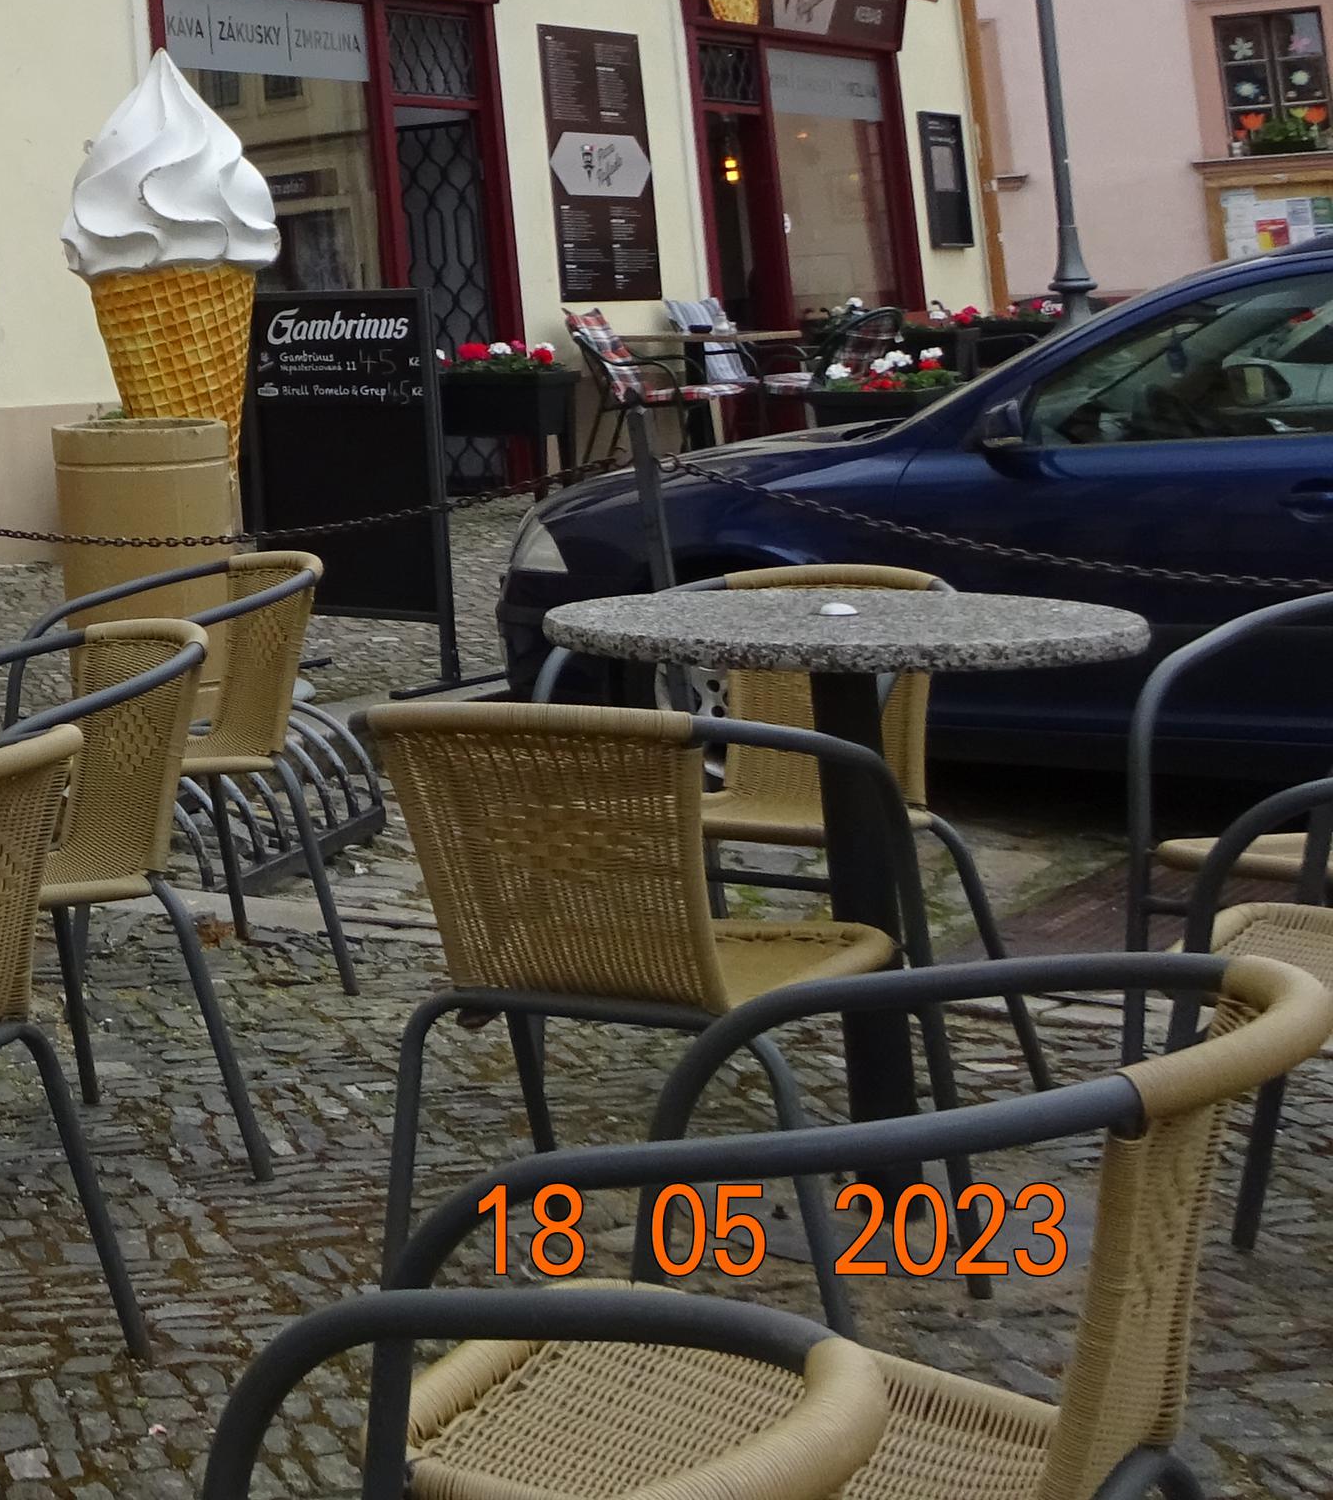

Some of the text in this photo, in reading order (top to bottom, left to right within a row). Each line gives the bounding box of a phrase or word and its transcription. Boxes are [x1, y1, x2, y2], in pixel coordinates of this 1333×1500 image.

[166, 11, 361, 53] KÁVA ZÁKUSKY ZMRZLINA
[267, 308, 409, 345] Gambrinus
[279, 350, 334, 362] Gambrinus
[313, 385, 350, 396] Pomelo
